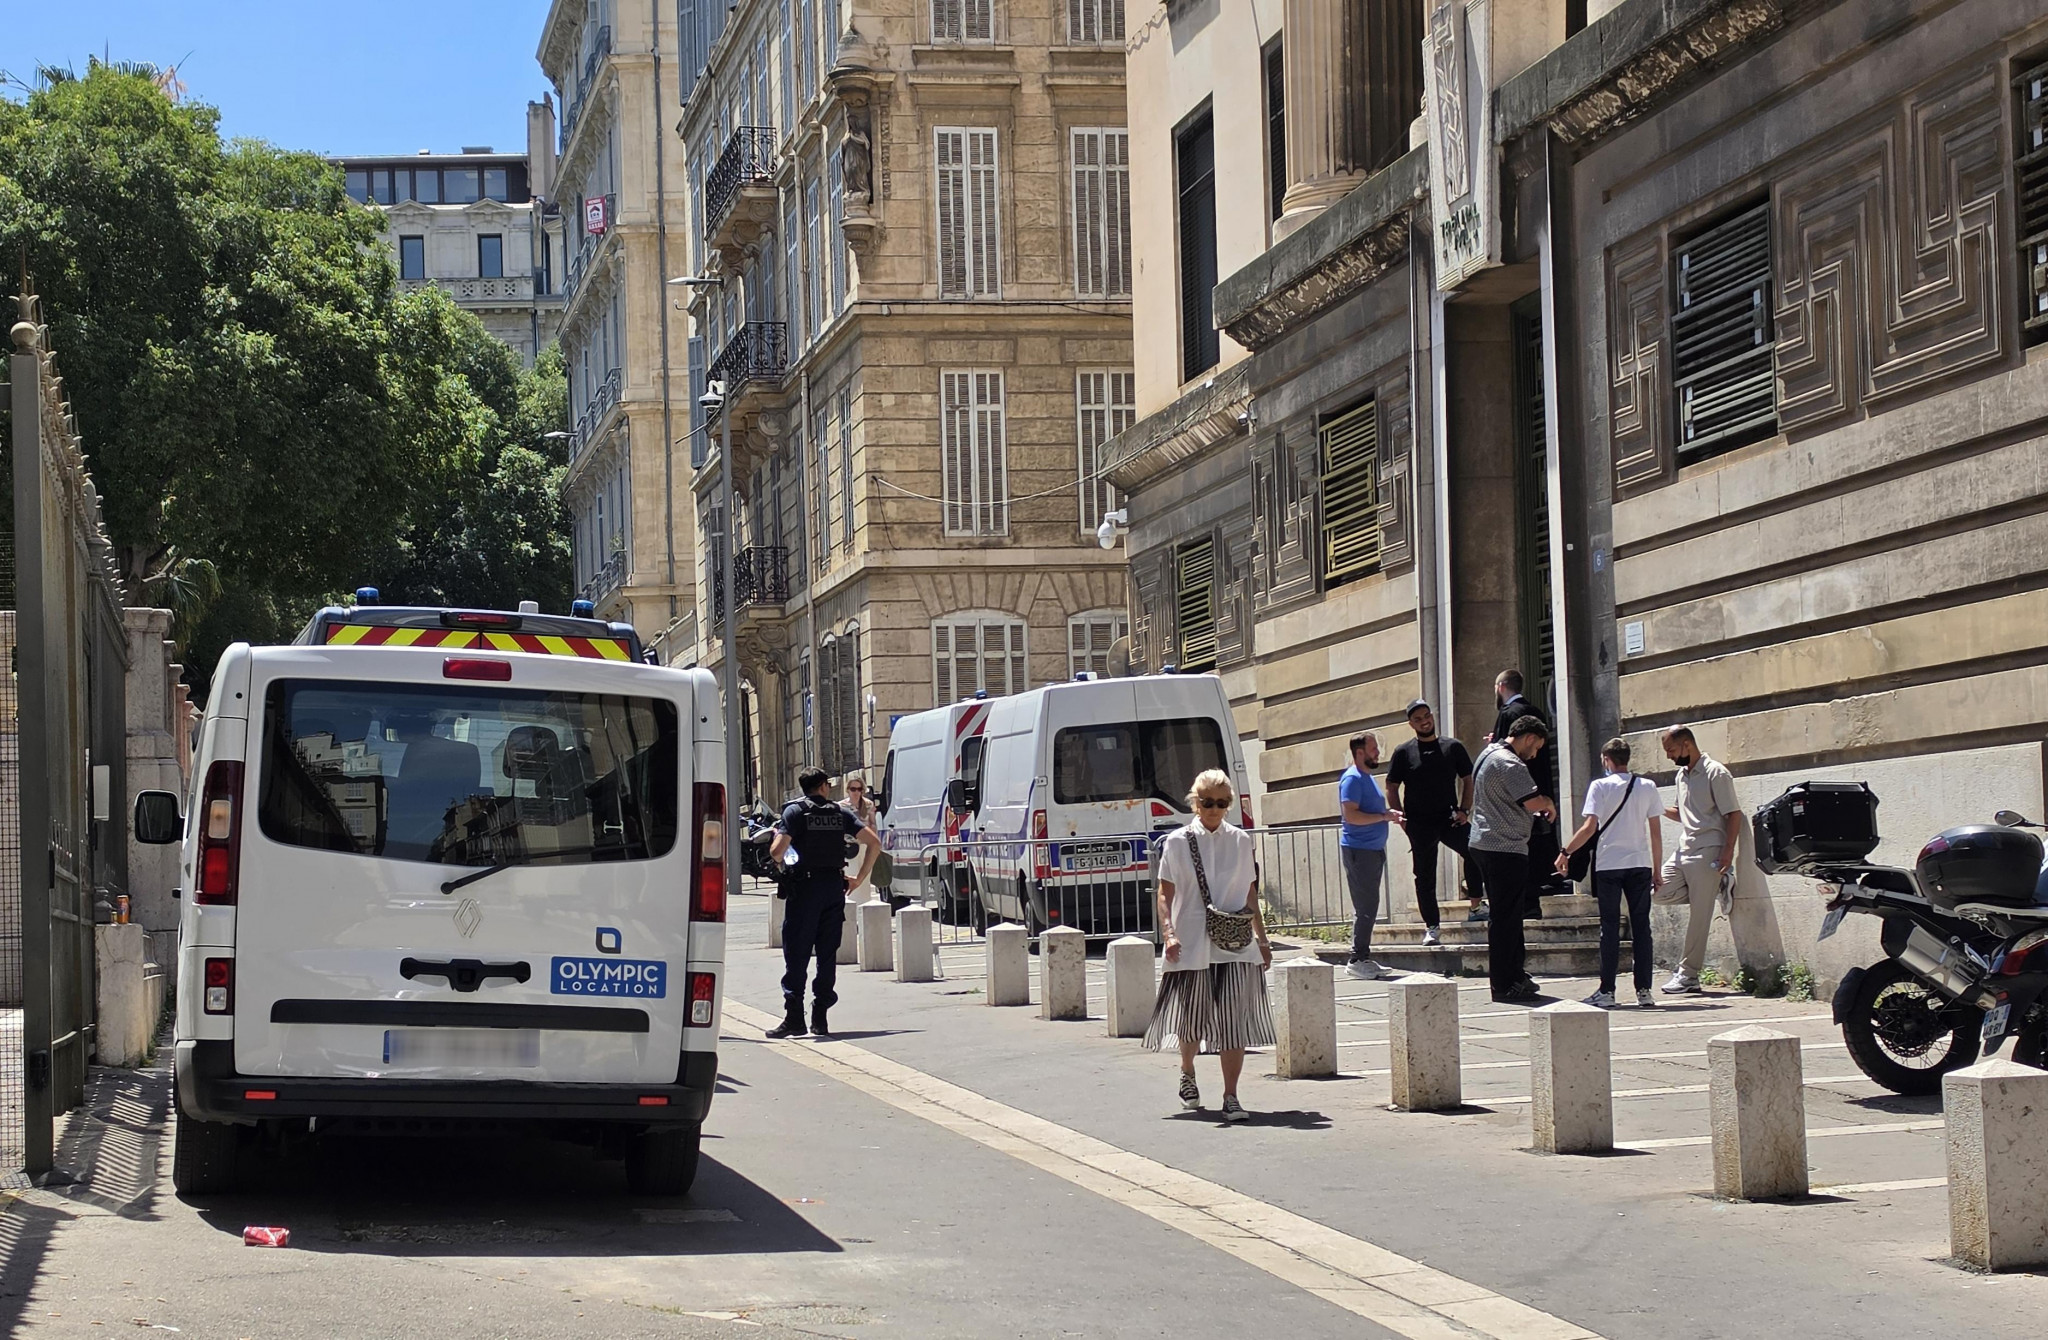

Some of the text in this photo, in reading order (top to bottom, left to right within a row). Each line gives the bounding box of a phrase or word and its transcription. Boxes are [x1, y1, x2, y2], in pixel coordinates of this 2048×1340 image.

[808, 815, 843, 827] POLICE
[897, 830, 921, 849] POLICE
[559, 962, 658, 982] OLYMPIC
[560, 981, 657, 994] LOCATION
